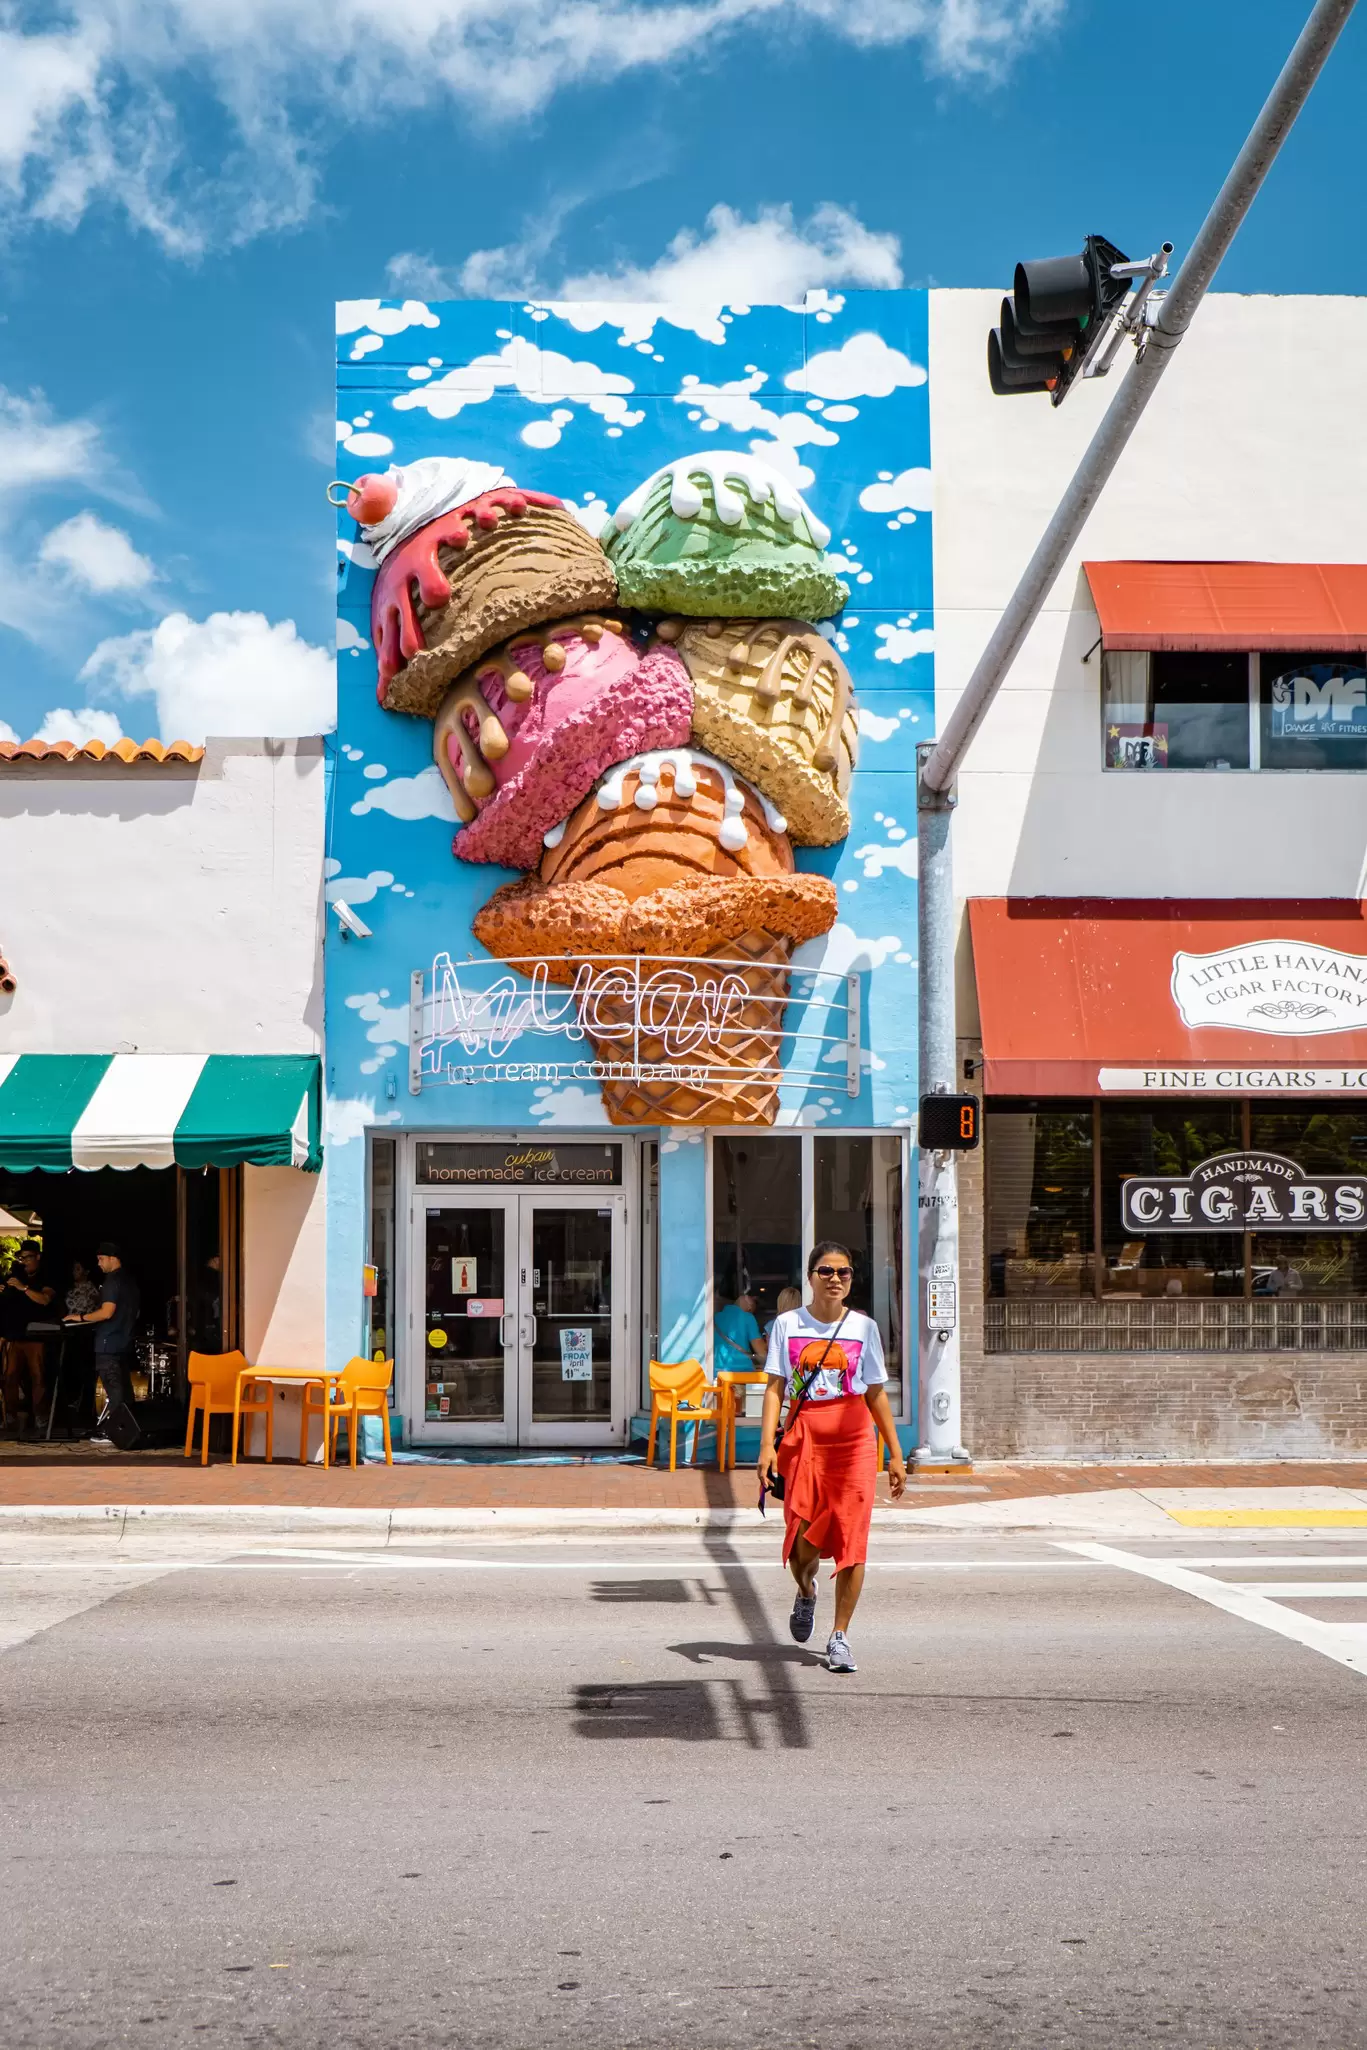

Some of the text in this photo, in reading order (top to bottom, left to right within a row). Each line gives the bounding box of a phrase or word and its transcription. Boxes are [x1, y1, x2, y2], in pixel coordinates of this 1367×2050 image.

[1285, 724, 1316, 732] DANCE
[1190, 955, 1269, 987] LITTLE
[1206, 980, 1265, 1006] CIGAR
[483, 1062, 559, 1082] cream
[573, 1060, 709, 1090] company
[1143, 1071, 1207, 1087] FINE
[1216, 1071, 1316, 1087] CIGARS
[961, 1106, 974, 1138] 8
[504, 1148, 556, 1167] cuban
[428, 1165, 613, 1181] homemade ice cream
[1201, 1159, 1295, 1182] HANDMADE
[1130, 1186, 1364, 1223] CIGARS
